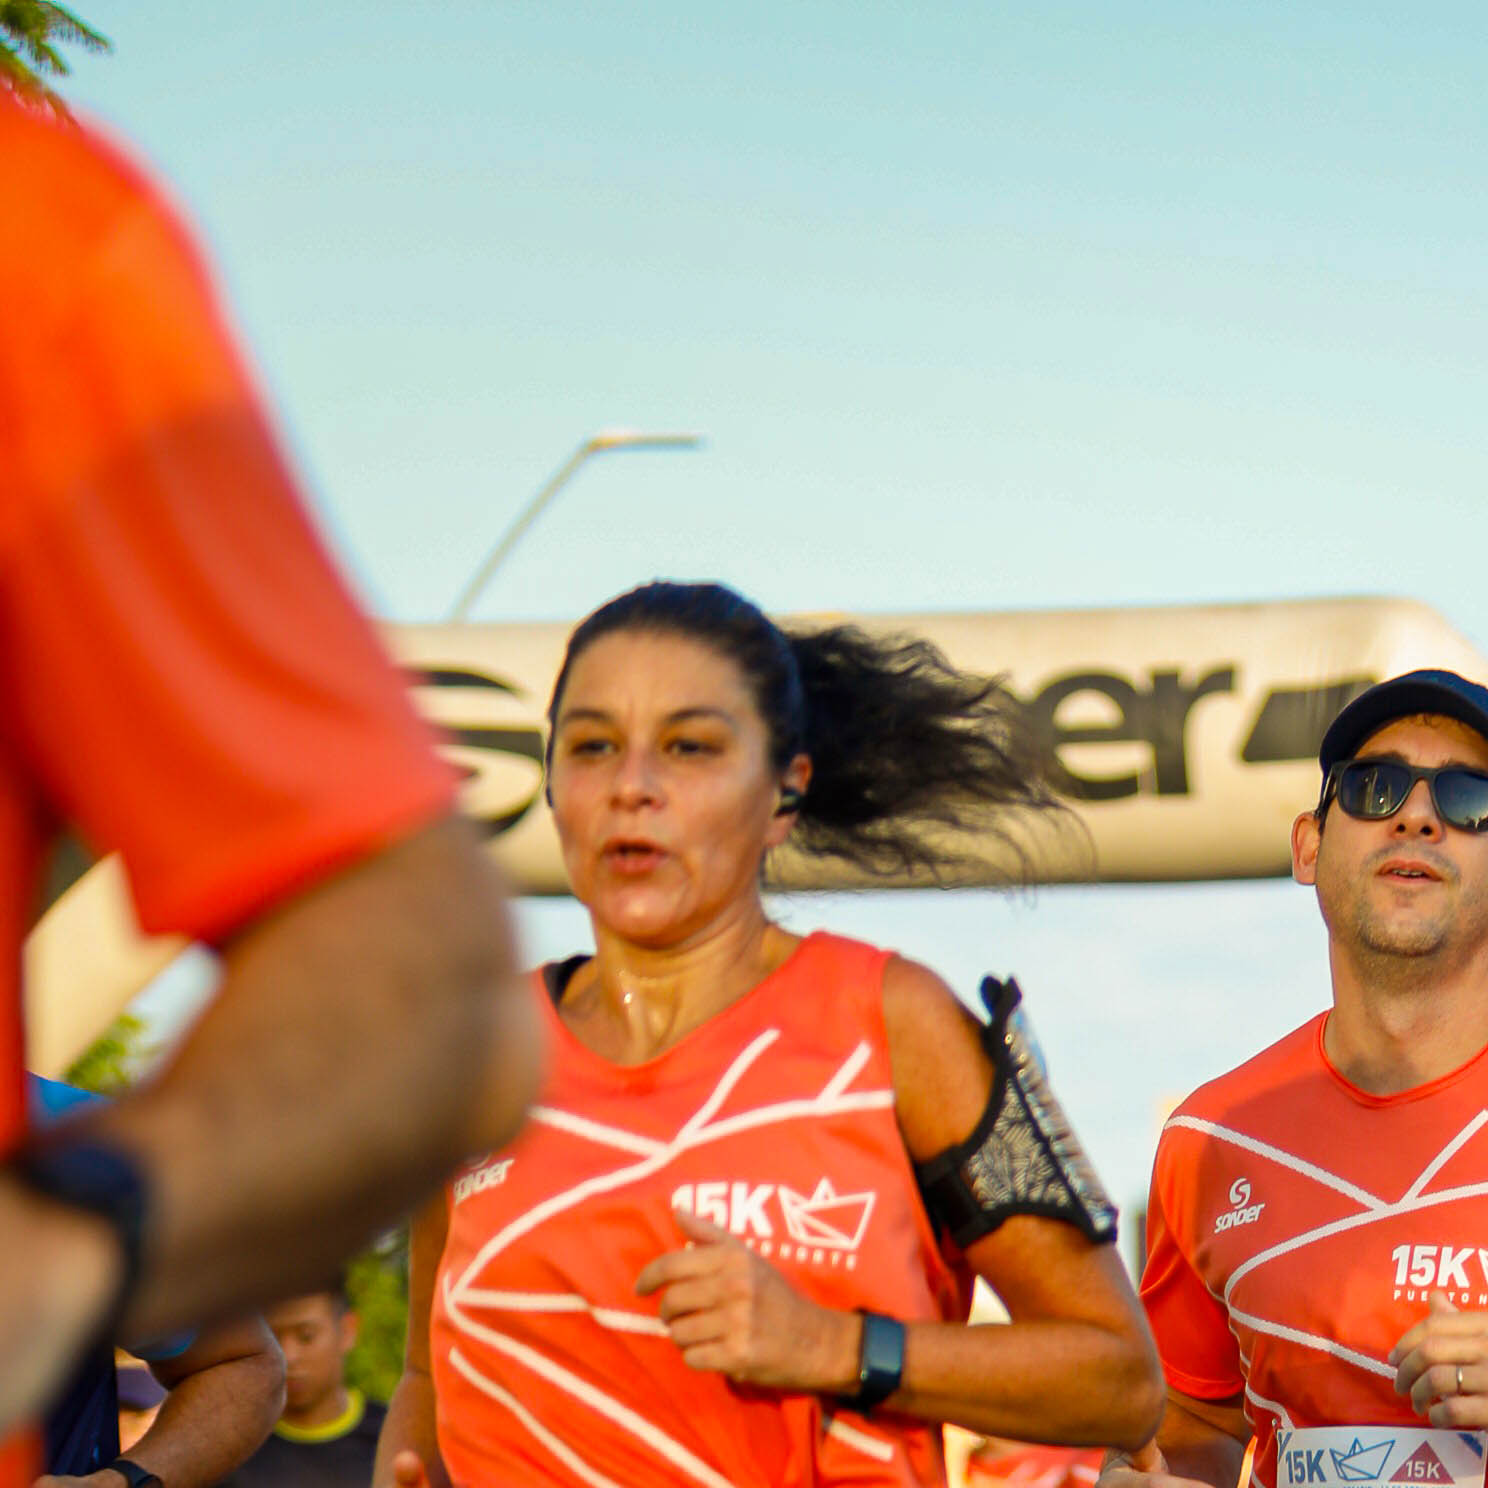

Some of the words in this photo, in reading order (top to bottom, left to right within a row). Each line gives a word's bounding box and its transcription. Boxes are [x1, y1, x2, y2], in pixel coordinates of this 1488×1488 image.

[1392, 1244, 1475, 1288] 15K
[1393, 1289, 1470, 1304] PUETO
[1285, 1448, 1327, 1484] 15K
[1405, 1460, 1441, 1479] 15K
